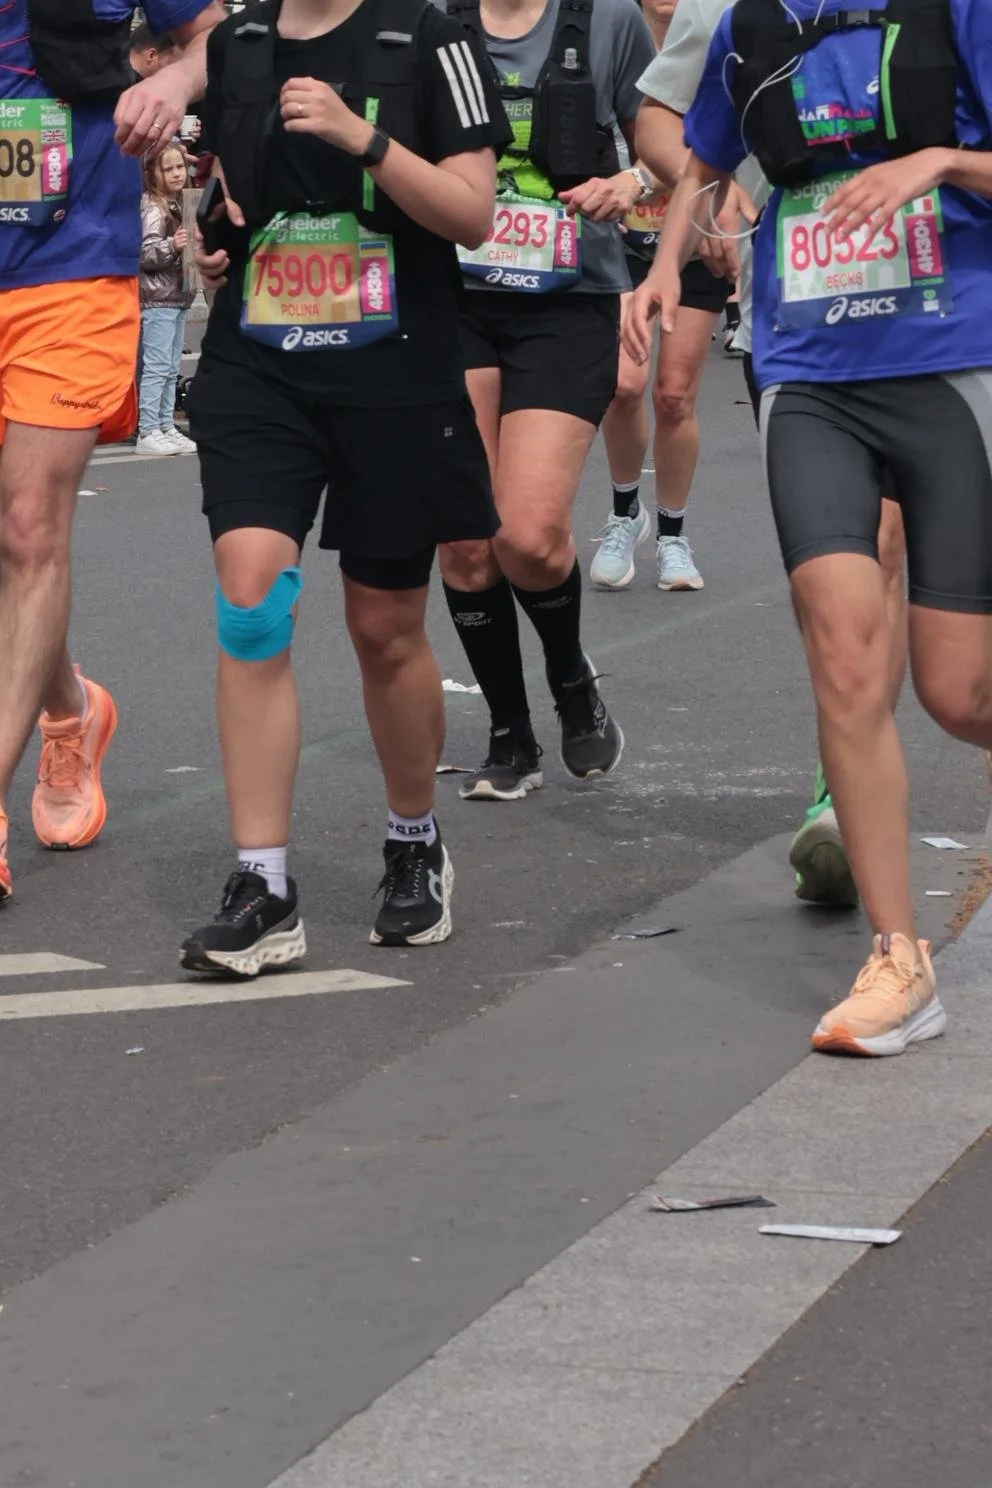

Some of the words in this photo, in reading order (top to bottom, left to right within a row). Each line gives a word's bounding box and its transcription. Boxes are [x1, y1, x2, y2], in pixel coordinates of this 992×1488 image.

[47, 147, 62, 191] 4H30+
[488, 250, 519, 262] CATHY
[560, 225, 572, 265] 4H30+
[254, 253, 353, 298] 75900
[367, 262, 383, 310] 4H30+
[502, 273, 540, 289] asics
[848, 297, 898, 318] asics
[302, 329, 349, 346] asics
